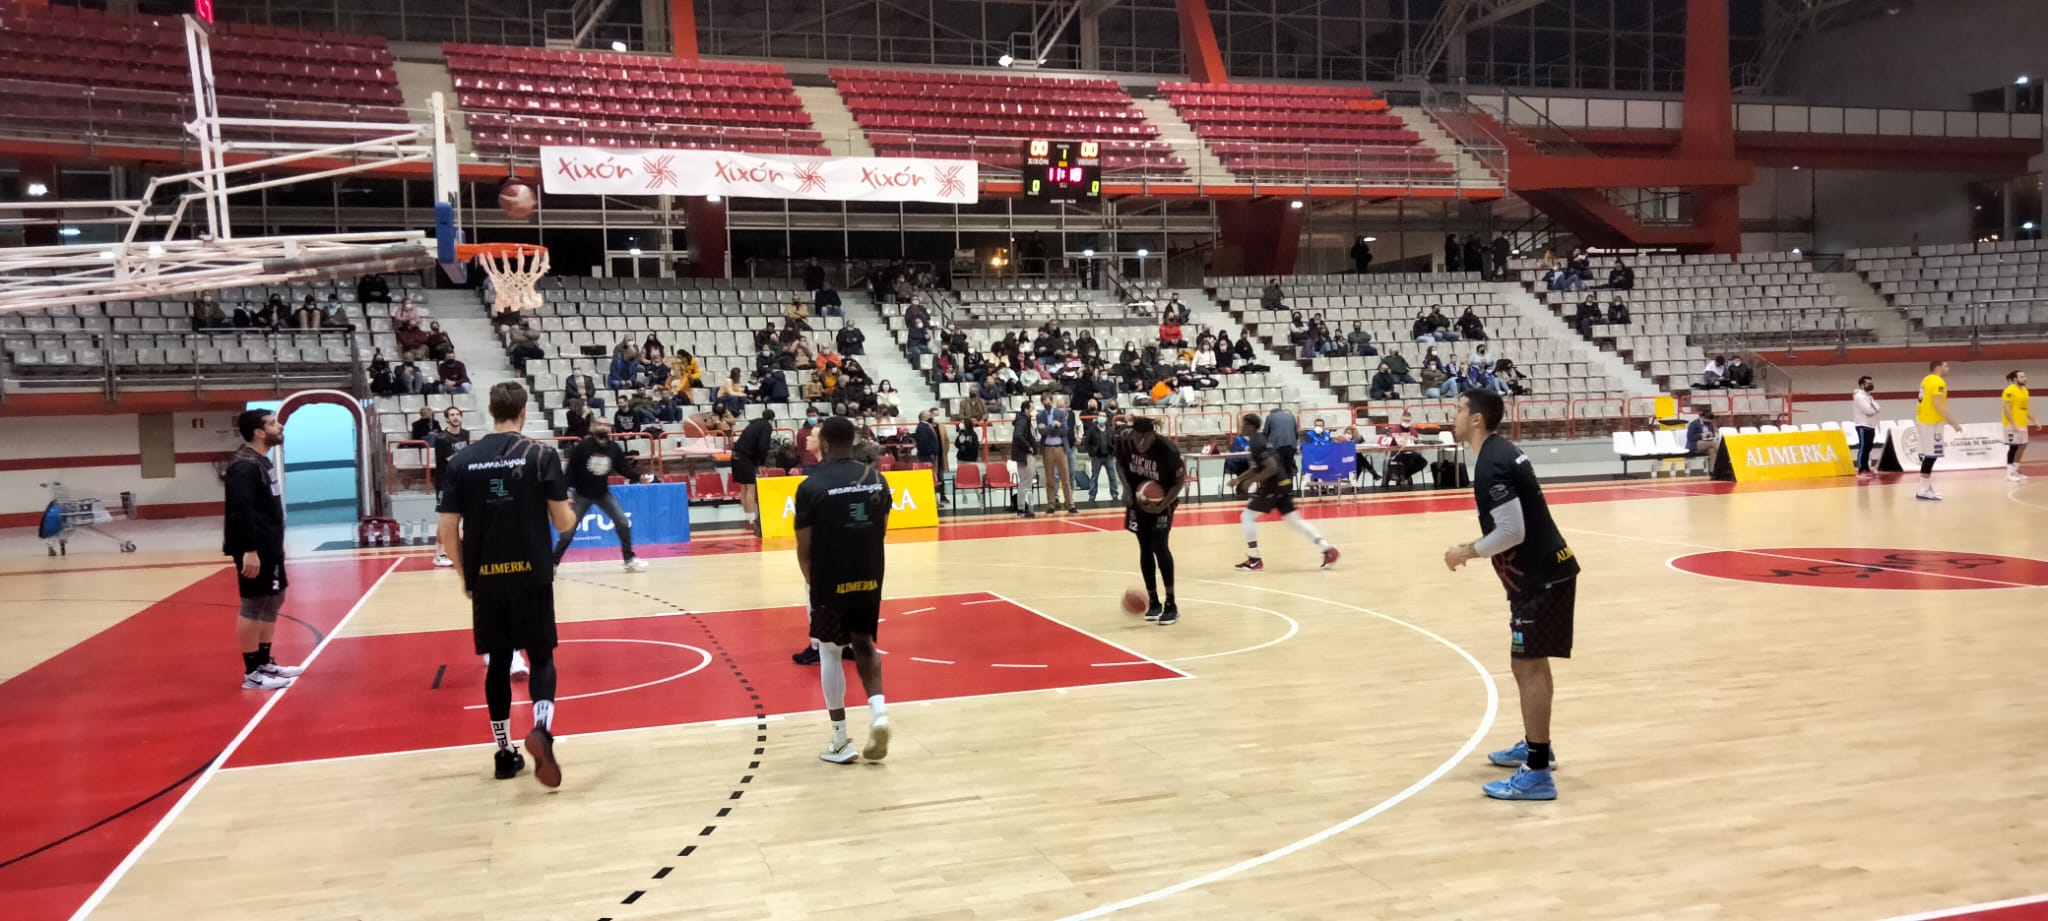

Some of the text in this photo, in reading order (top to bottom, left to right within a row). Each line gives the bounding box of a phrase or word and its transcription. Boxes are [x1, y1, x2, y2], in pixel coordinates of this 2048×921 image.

[1030, 140, 1049, 157] 00
[1081, 142, 1099, 158] 00
[558, 156, 634, 183] Xixón
[714, 160, 785, 184] Xixón
[860, 166, 926, 189] Xixón
[1032, 179, 1041, 193] 0
[1091, 180, 1100, 194] 0
[1746, 443, 1839, 467] ALIMERKA
[479, 561, 532, 575] ALIMERKA
